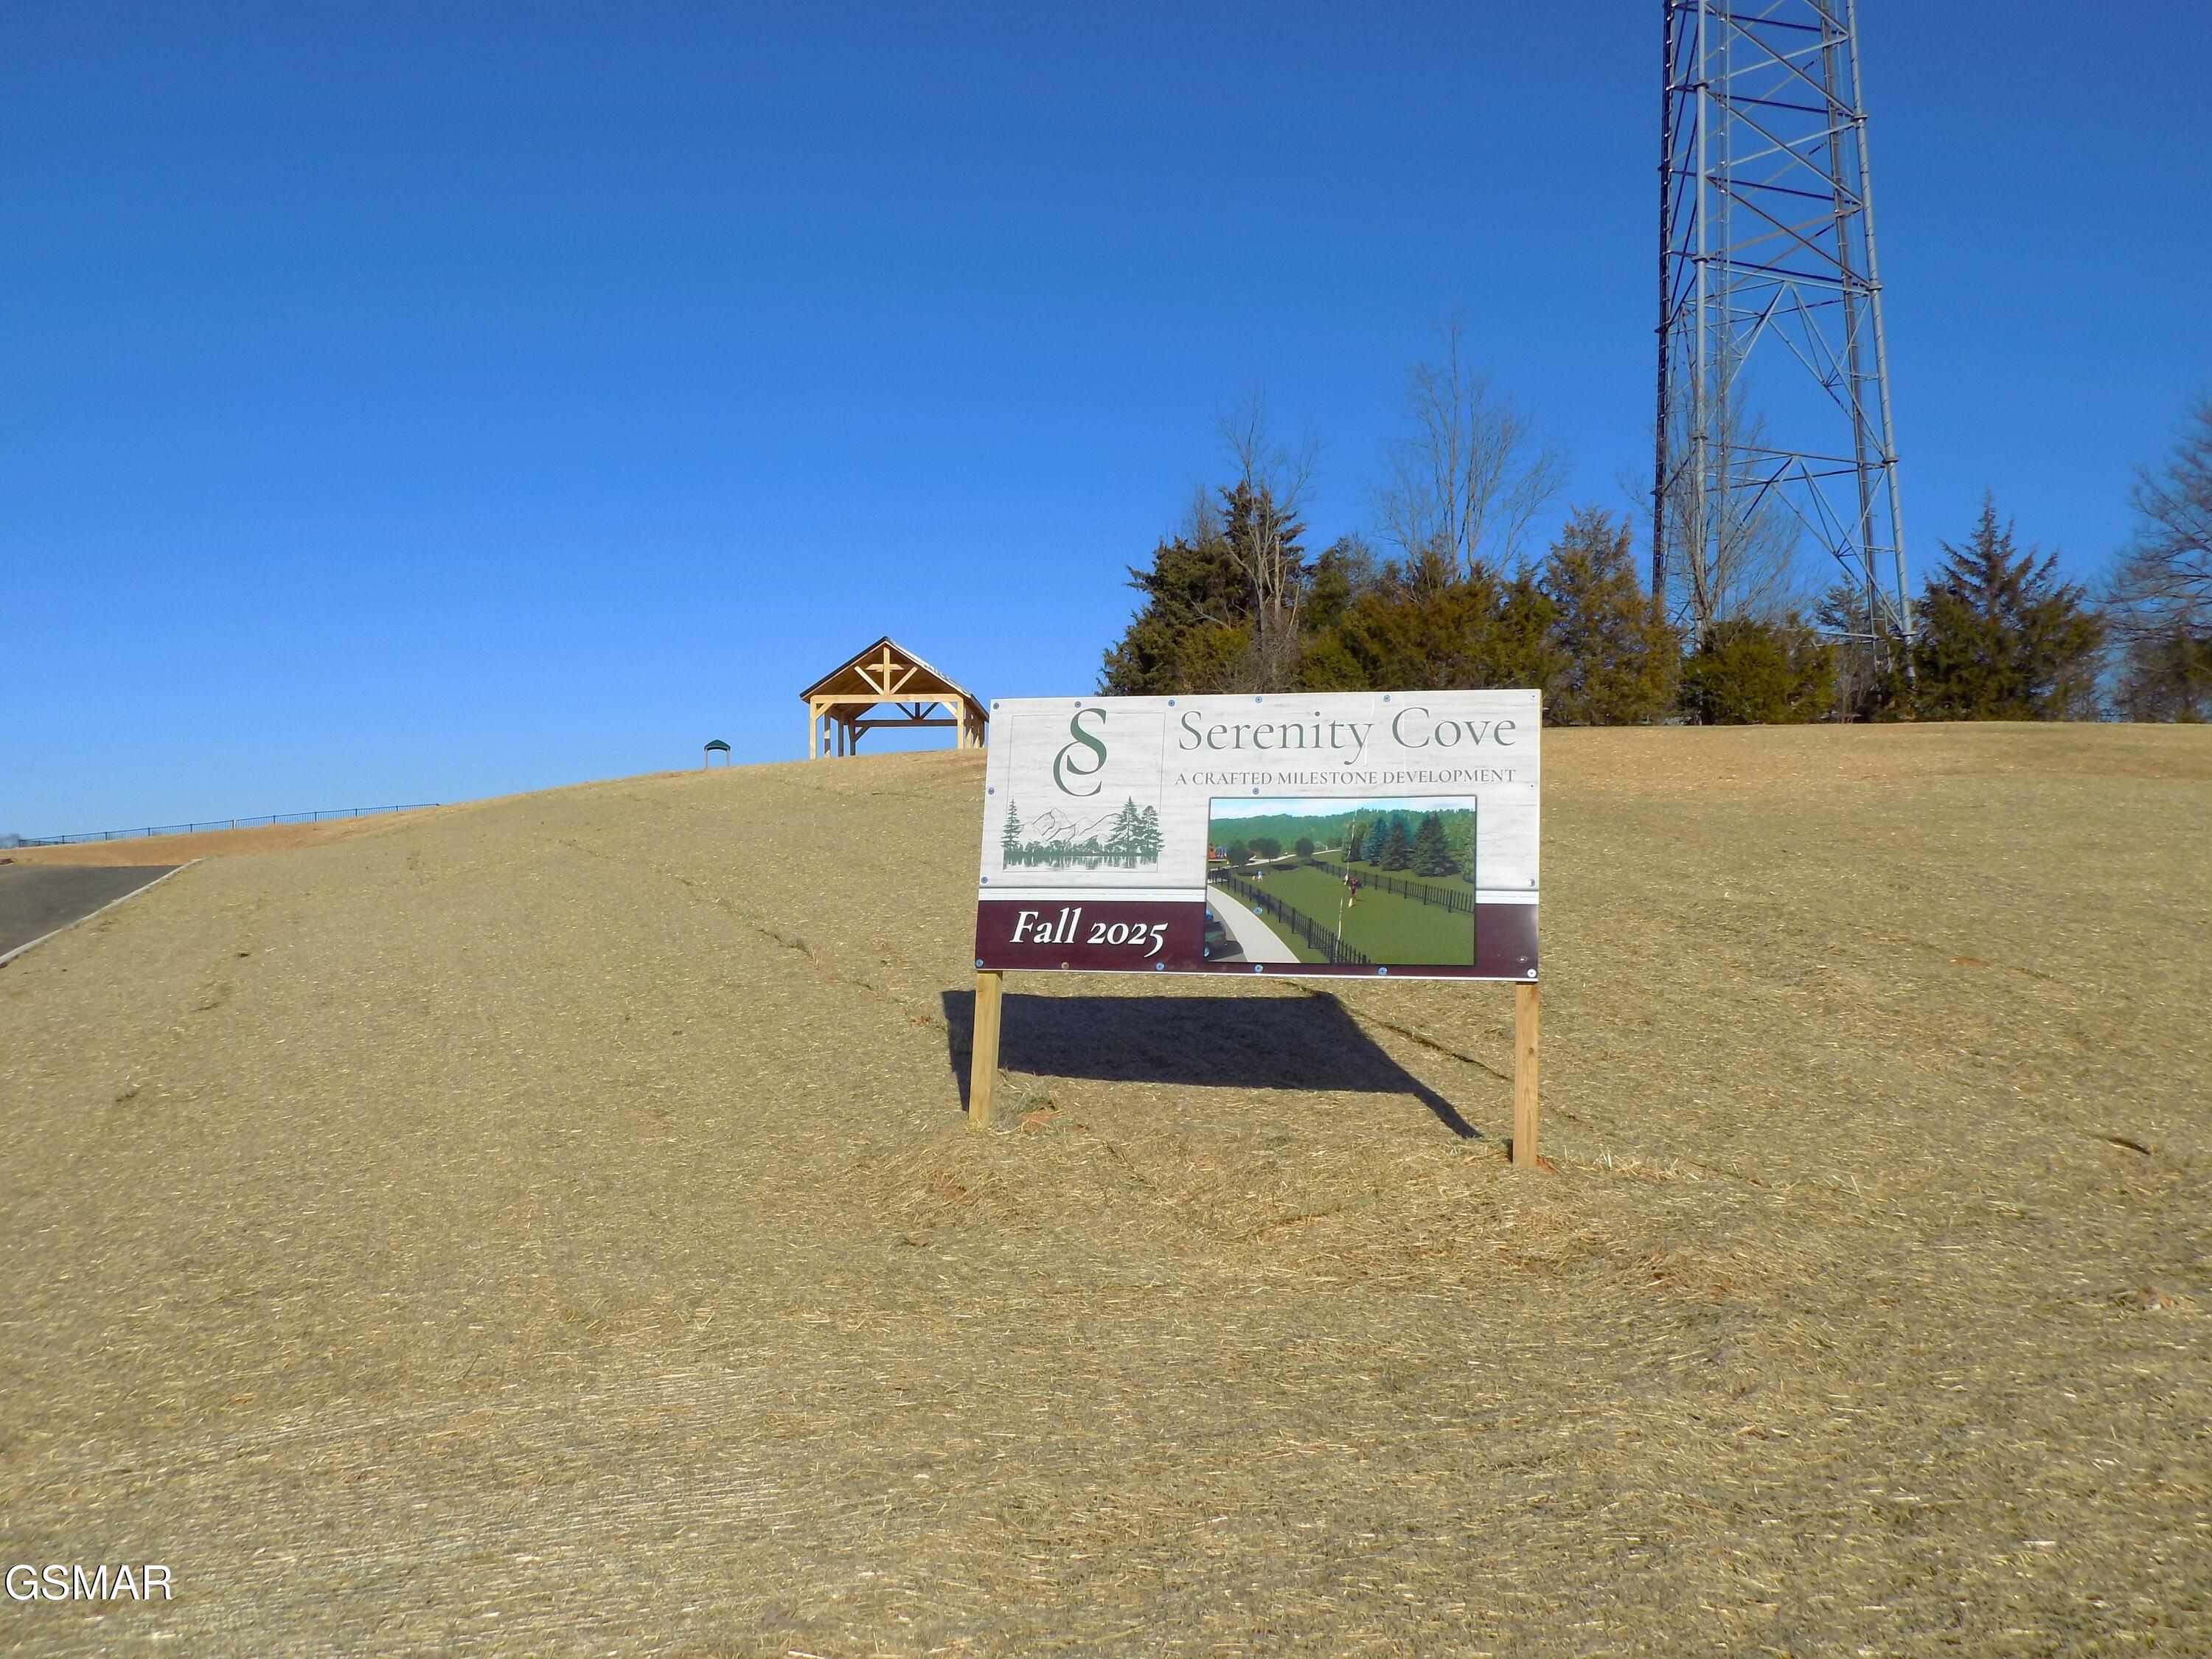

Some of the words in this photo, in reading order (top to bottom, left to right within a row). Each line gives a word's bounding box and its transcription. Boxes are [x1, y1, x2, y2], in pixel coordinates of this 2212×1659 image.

[1178, 711, 1374, 765] Serenity
[1391, 707, 1517, 748] Cove
[1175, 772, 1187, 785] A
[1192, 772, 1273, 785] CRAFTED
[1278, 771, 1377, 785] MILESTONE
[1383, 769, 1517, 784] DEVELOPMENT
[1009, 907, 1082, 944] Fall
[1086, 922, 1169, 959] 2025
